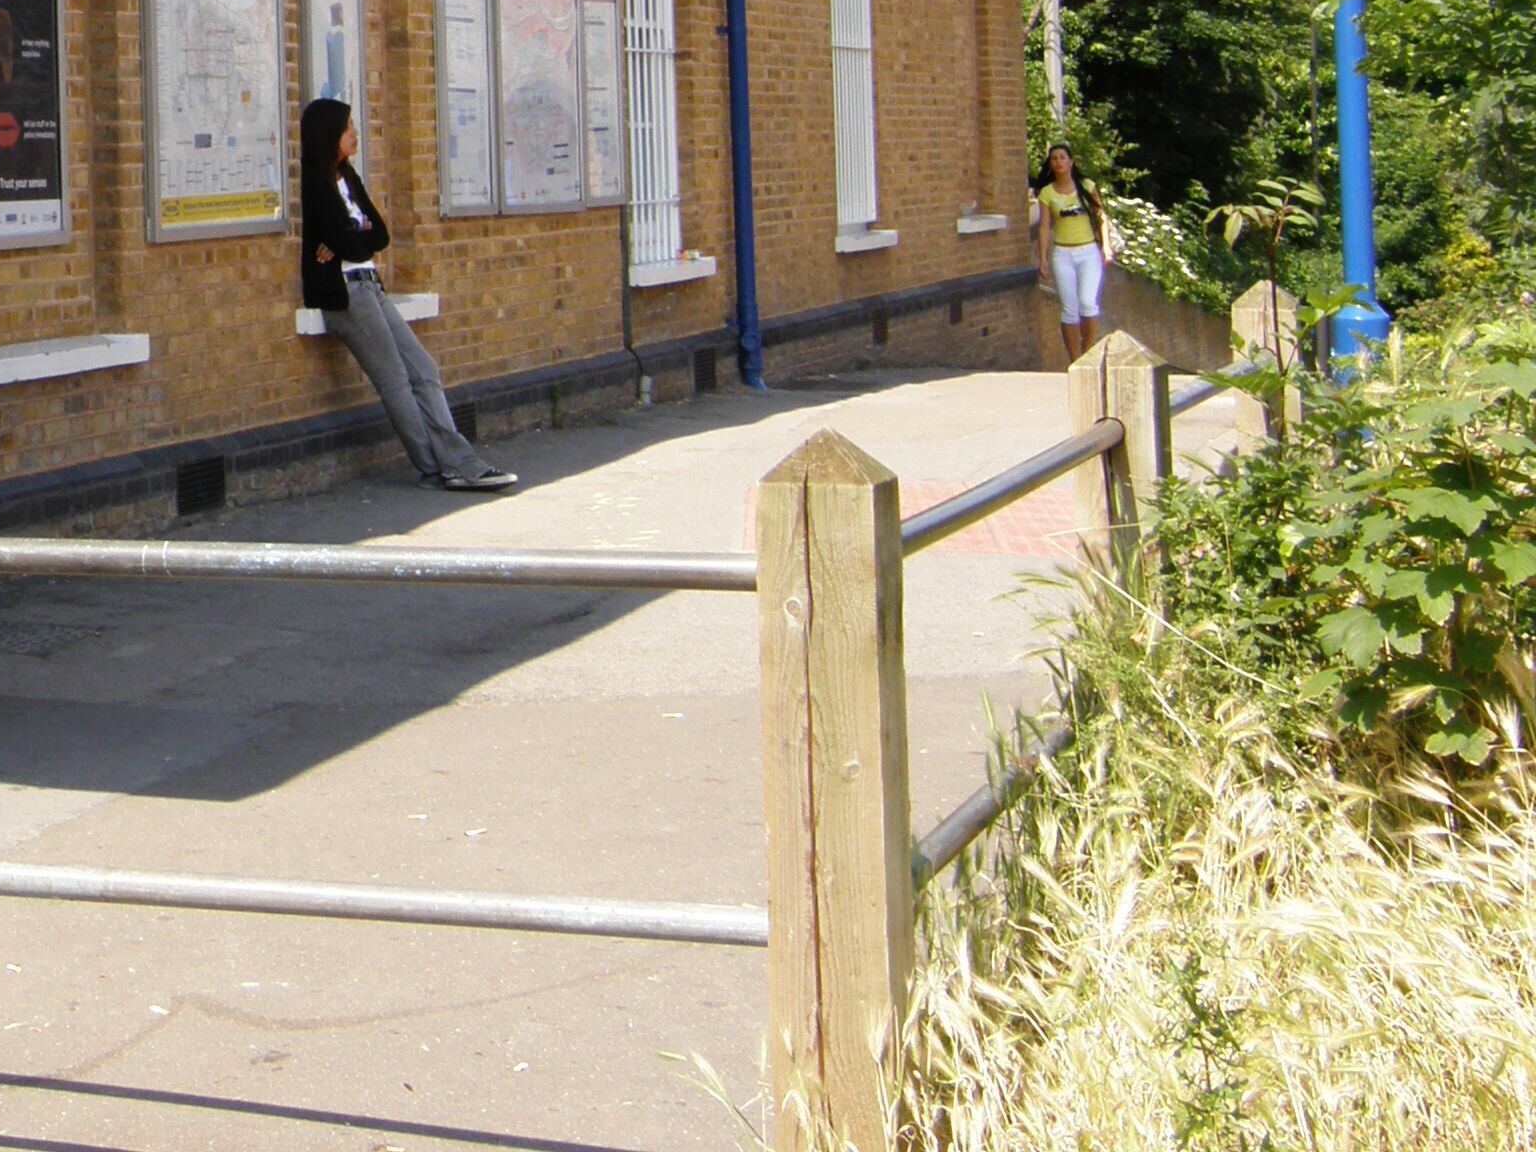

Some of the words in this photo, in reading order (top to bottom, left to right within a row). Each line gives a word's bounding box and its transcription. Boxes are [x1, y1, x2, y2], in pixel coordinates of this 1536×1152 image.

[0, 177, 15, 189] Trust
[15, 179, 27, 190] your
[28, 178, 47, 189] senses
